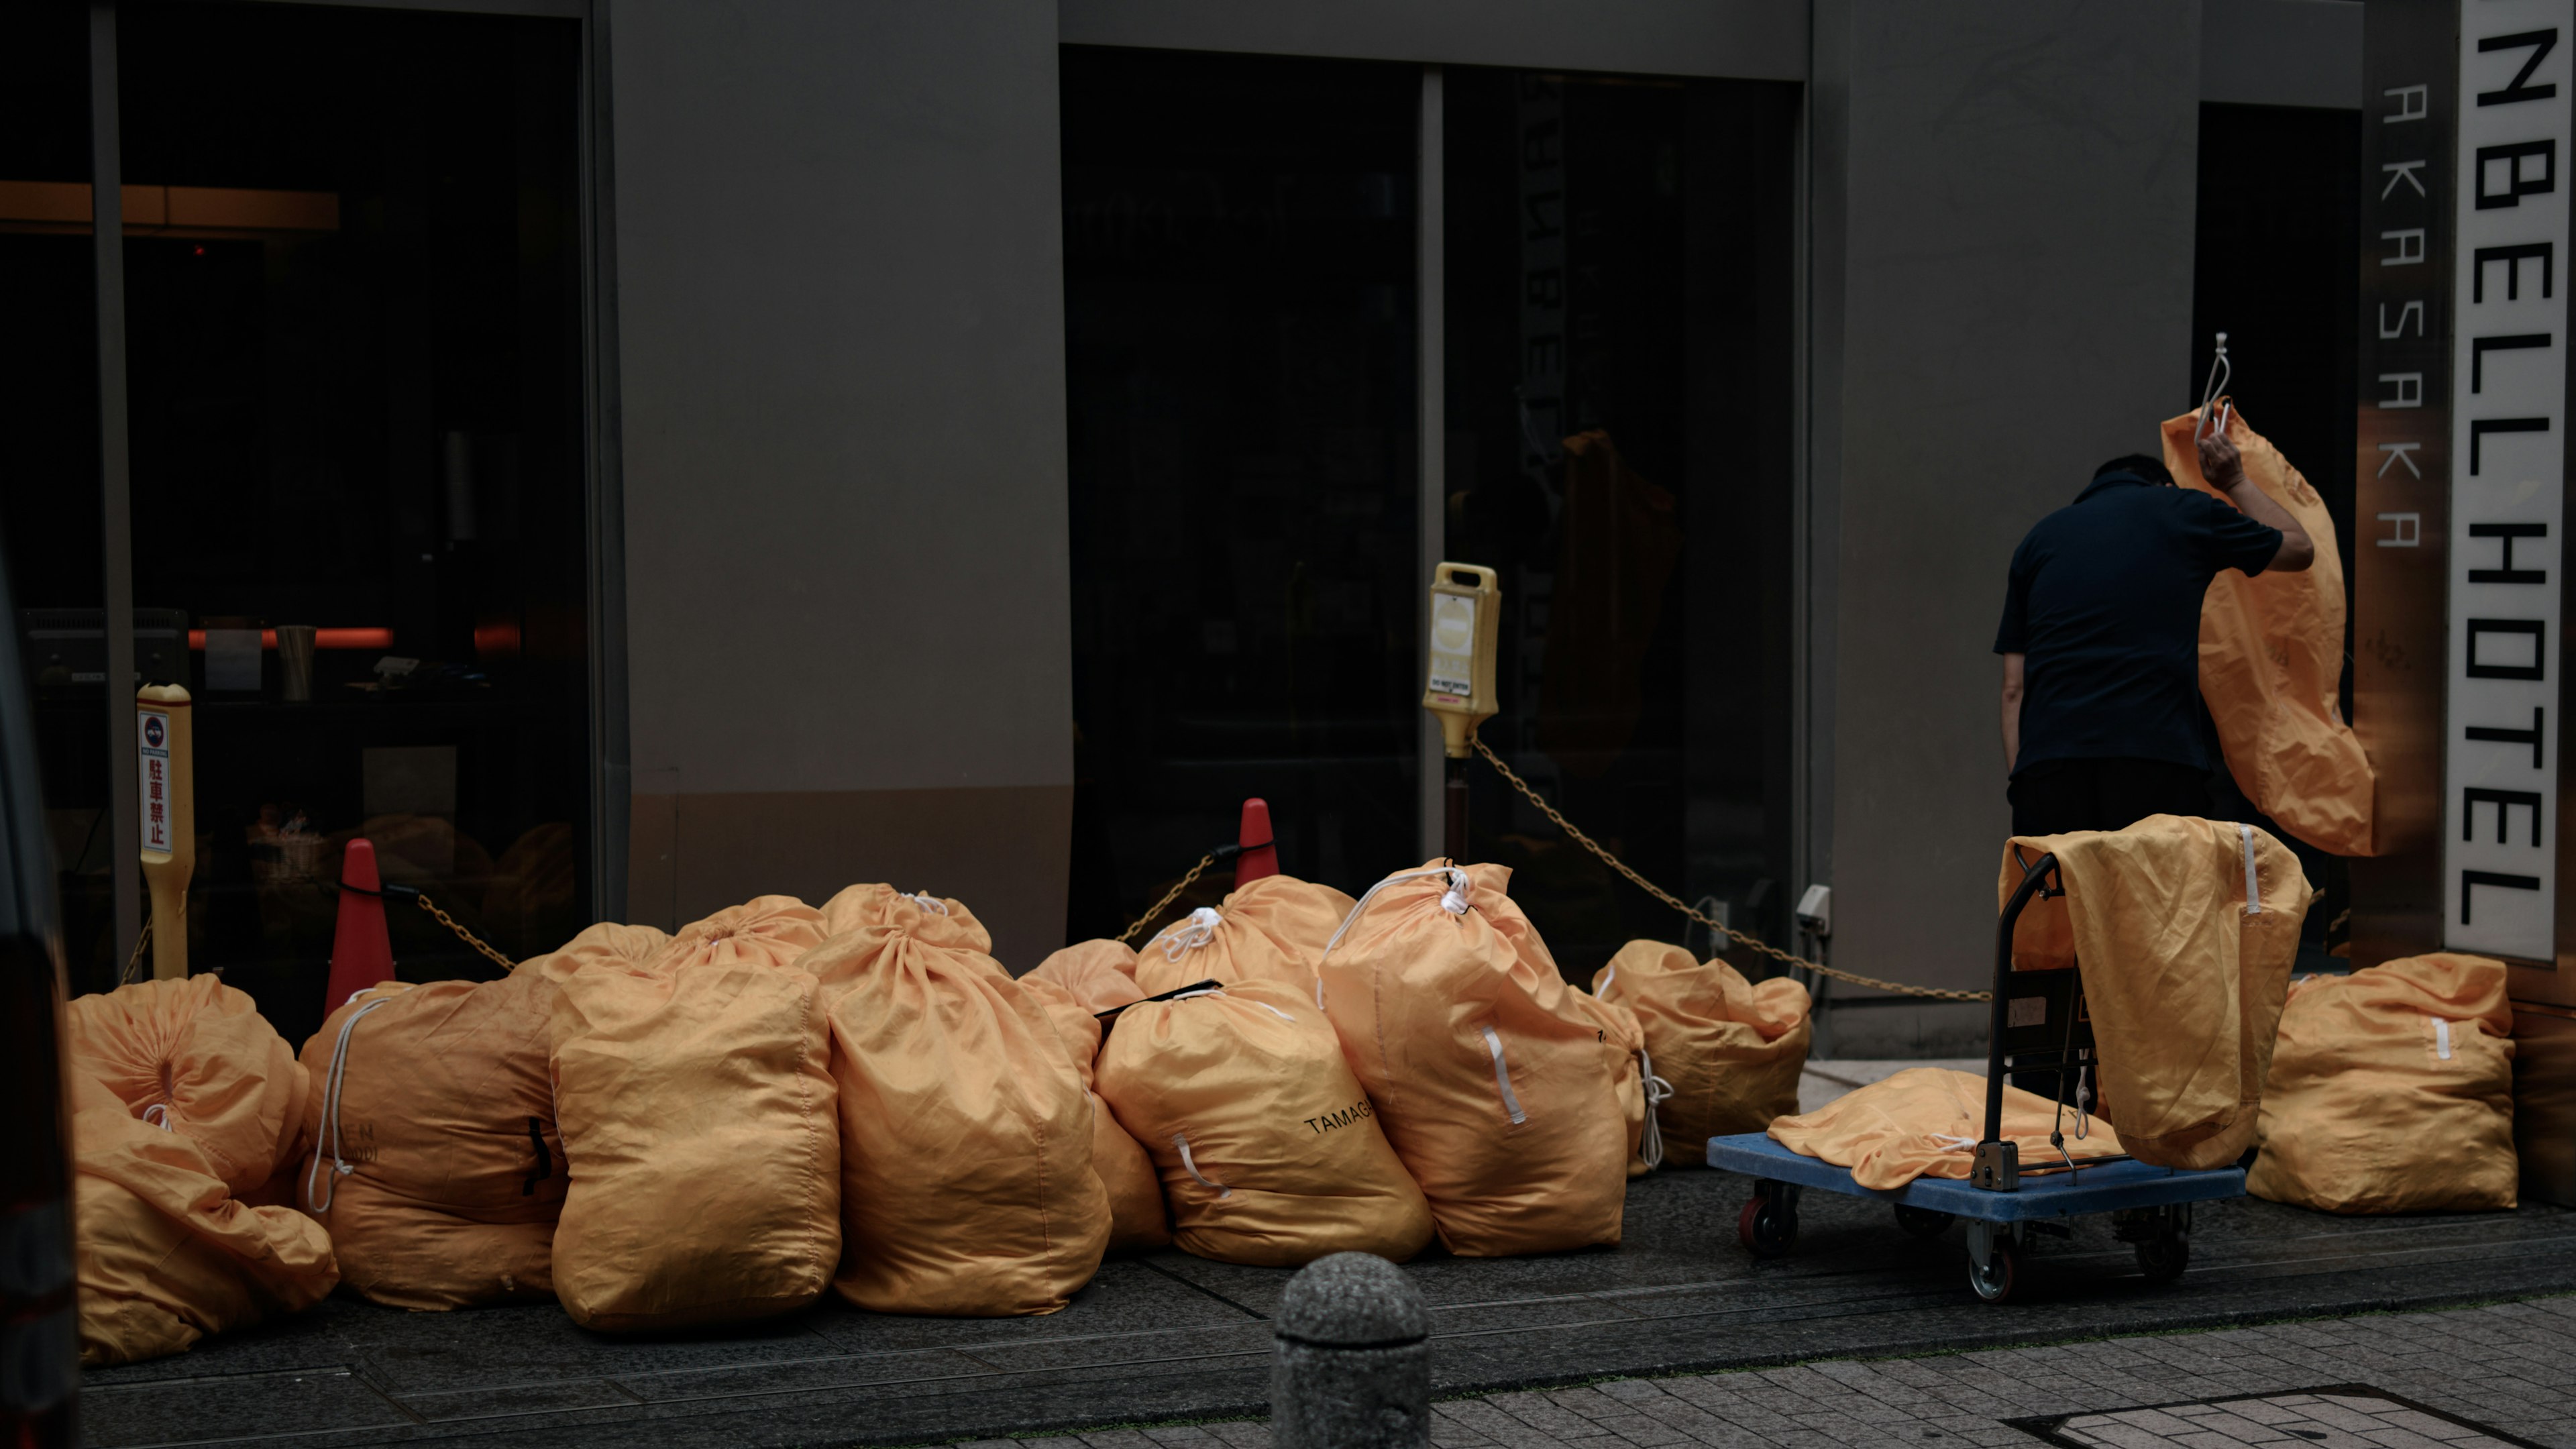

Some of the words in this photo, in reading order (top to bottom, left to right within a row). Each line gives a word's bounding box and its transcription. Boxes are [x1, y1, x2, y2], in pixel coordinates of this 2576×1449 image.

[2375, 83, 2427, 547] AKASAKA
[2471, 28, 2557, 476] NBELL
[149, 759, 164, 845] 駐車禁止
[2462, 524, 2546, 924] HOTEL
